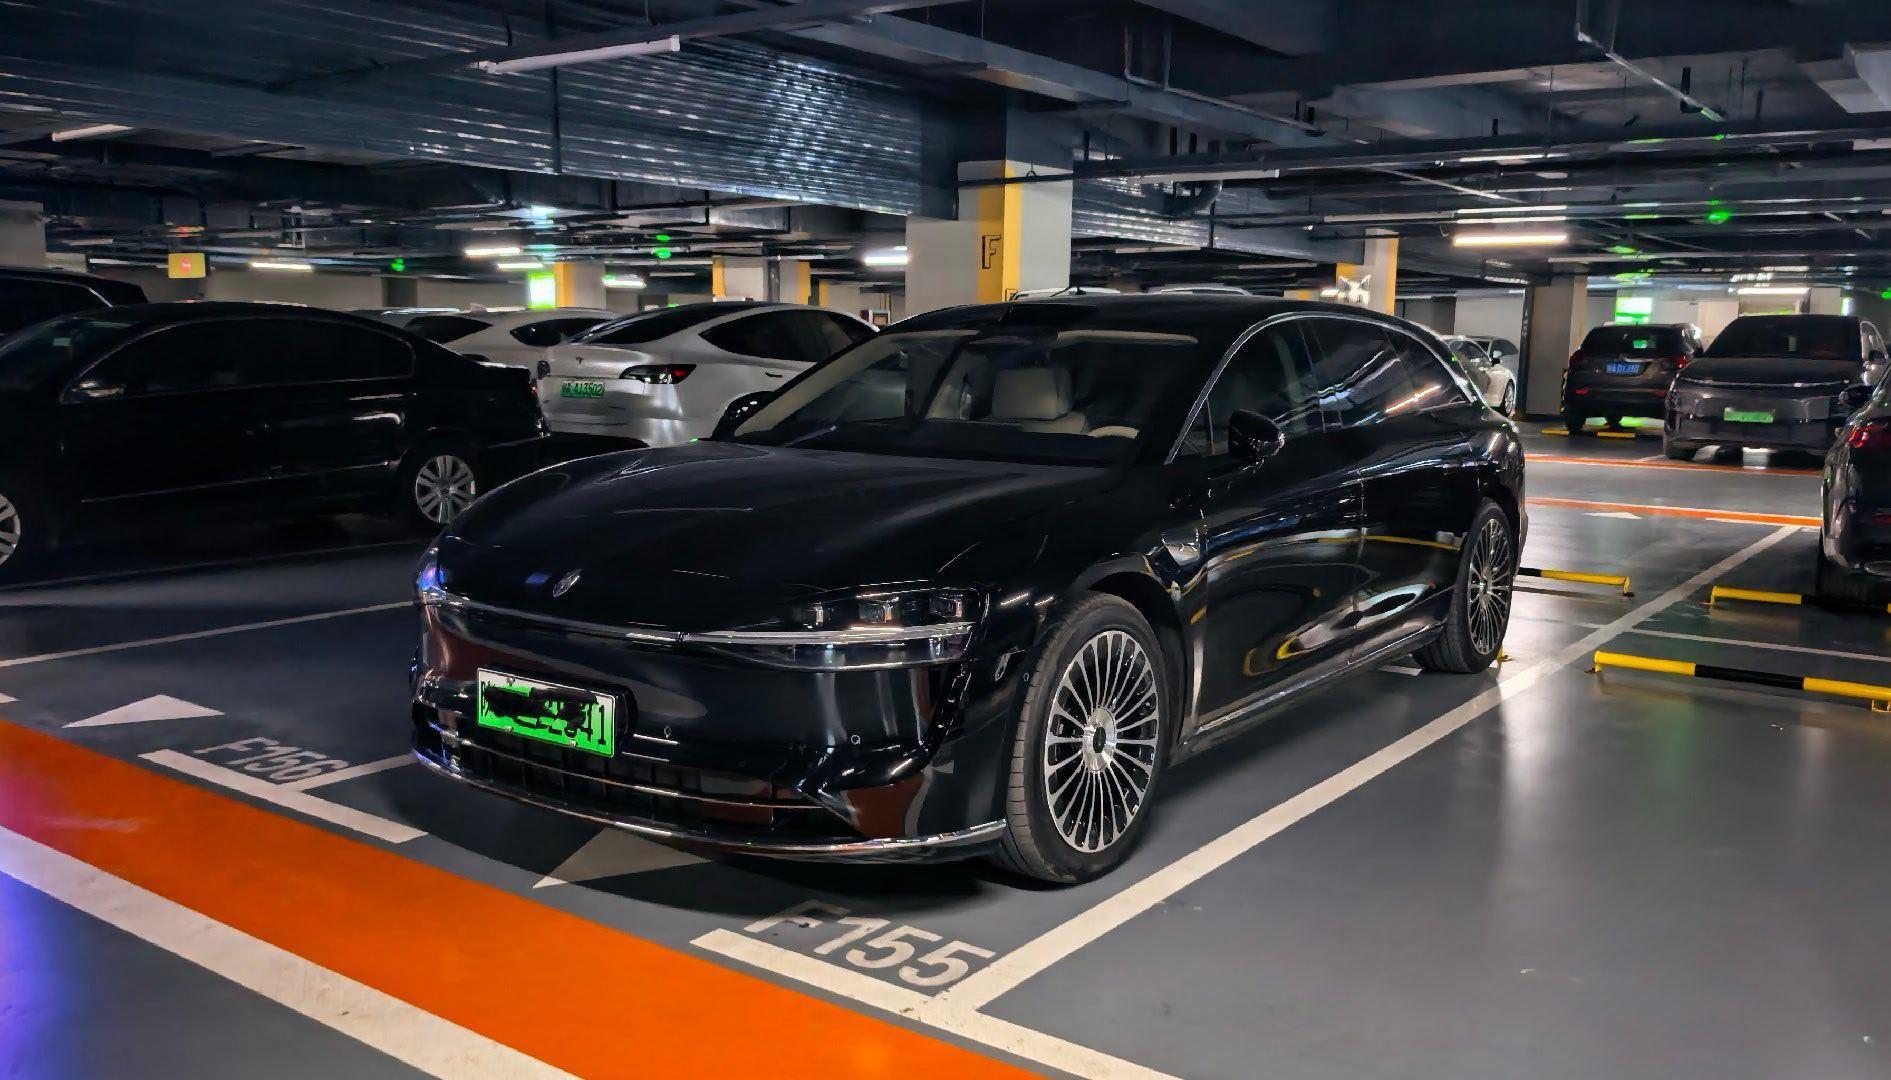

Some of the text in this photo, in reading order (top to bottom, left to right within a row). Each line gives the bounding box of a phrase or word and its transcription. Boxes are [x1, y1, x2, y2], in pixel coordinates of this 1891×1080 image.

[981, 234, 1002, 270] F
[194, 736, 350, 781] F156
[744, 900, 996, 987] F155
